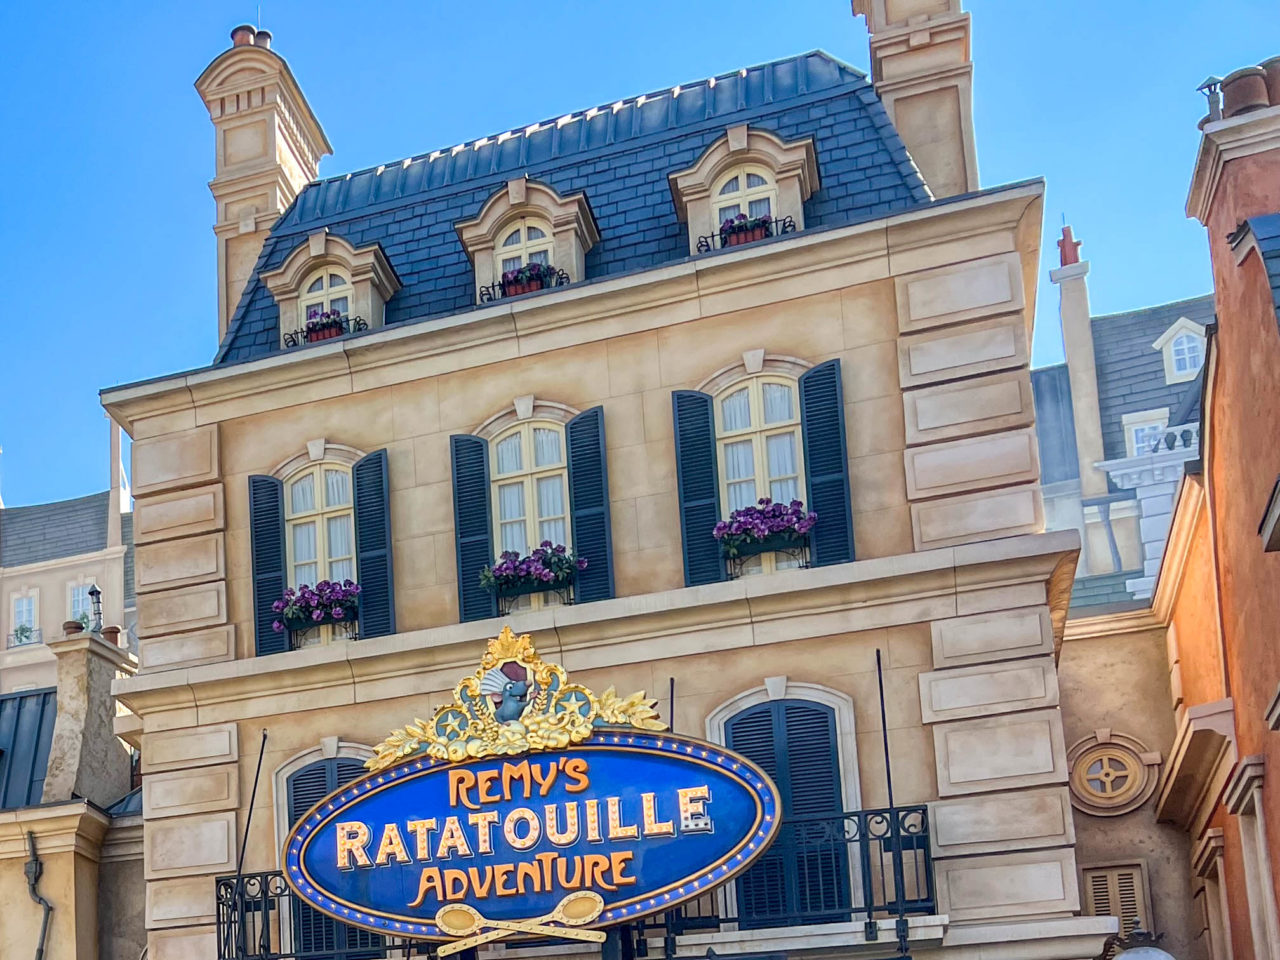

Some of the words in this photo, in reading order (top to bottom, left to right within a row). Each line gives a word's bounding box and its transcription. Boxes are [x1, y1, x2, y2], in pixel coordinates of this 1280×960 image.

[448, 756, 591, 810] REMY'S
[335, 785, 715, 872] RATATOUILLE
[407, 850, 637, 907] ADVENTURE
